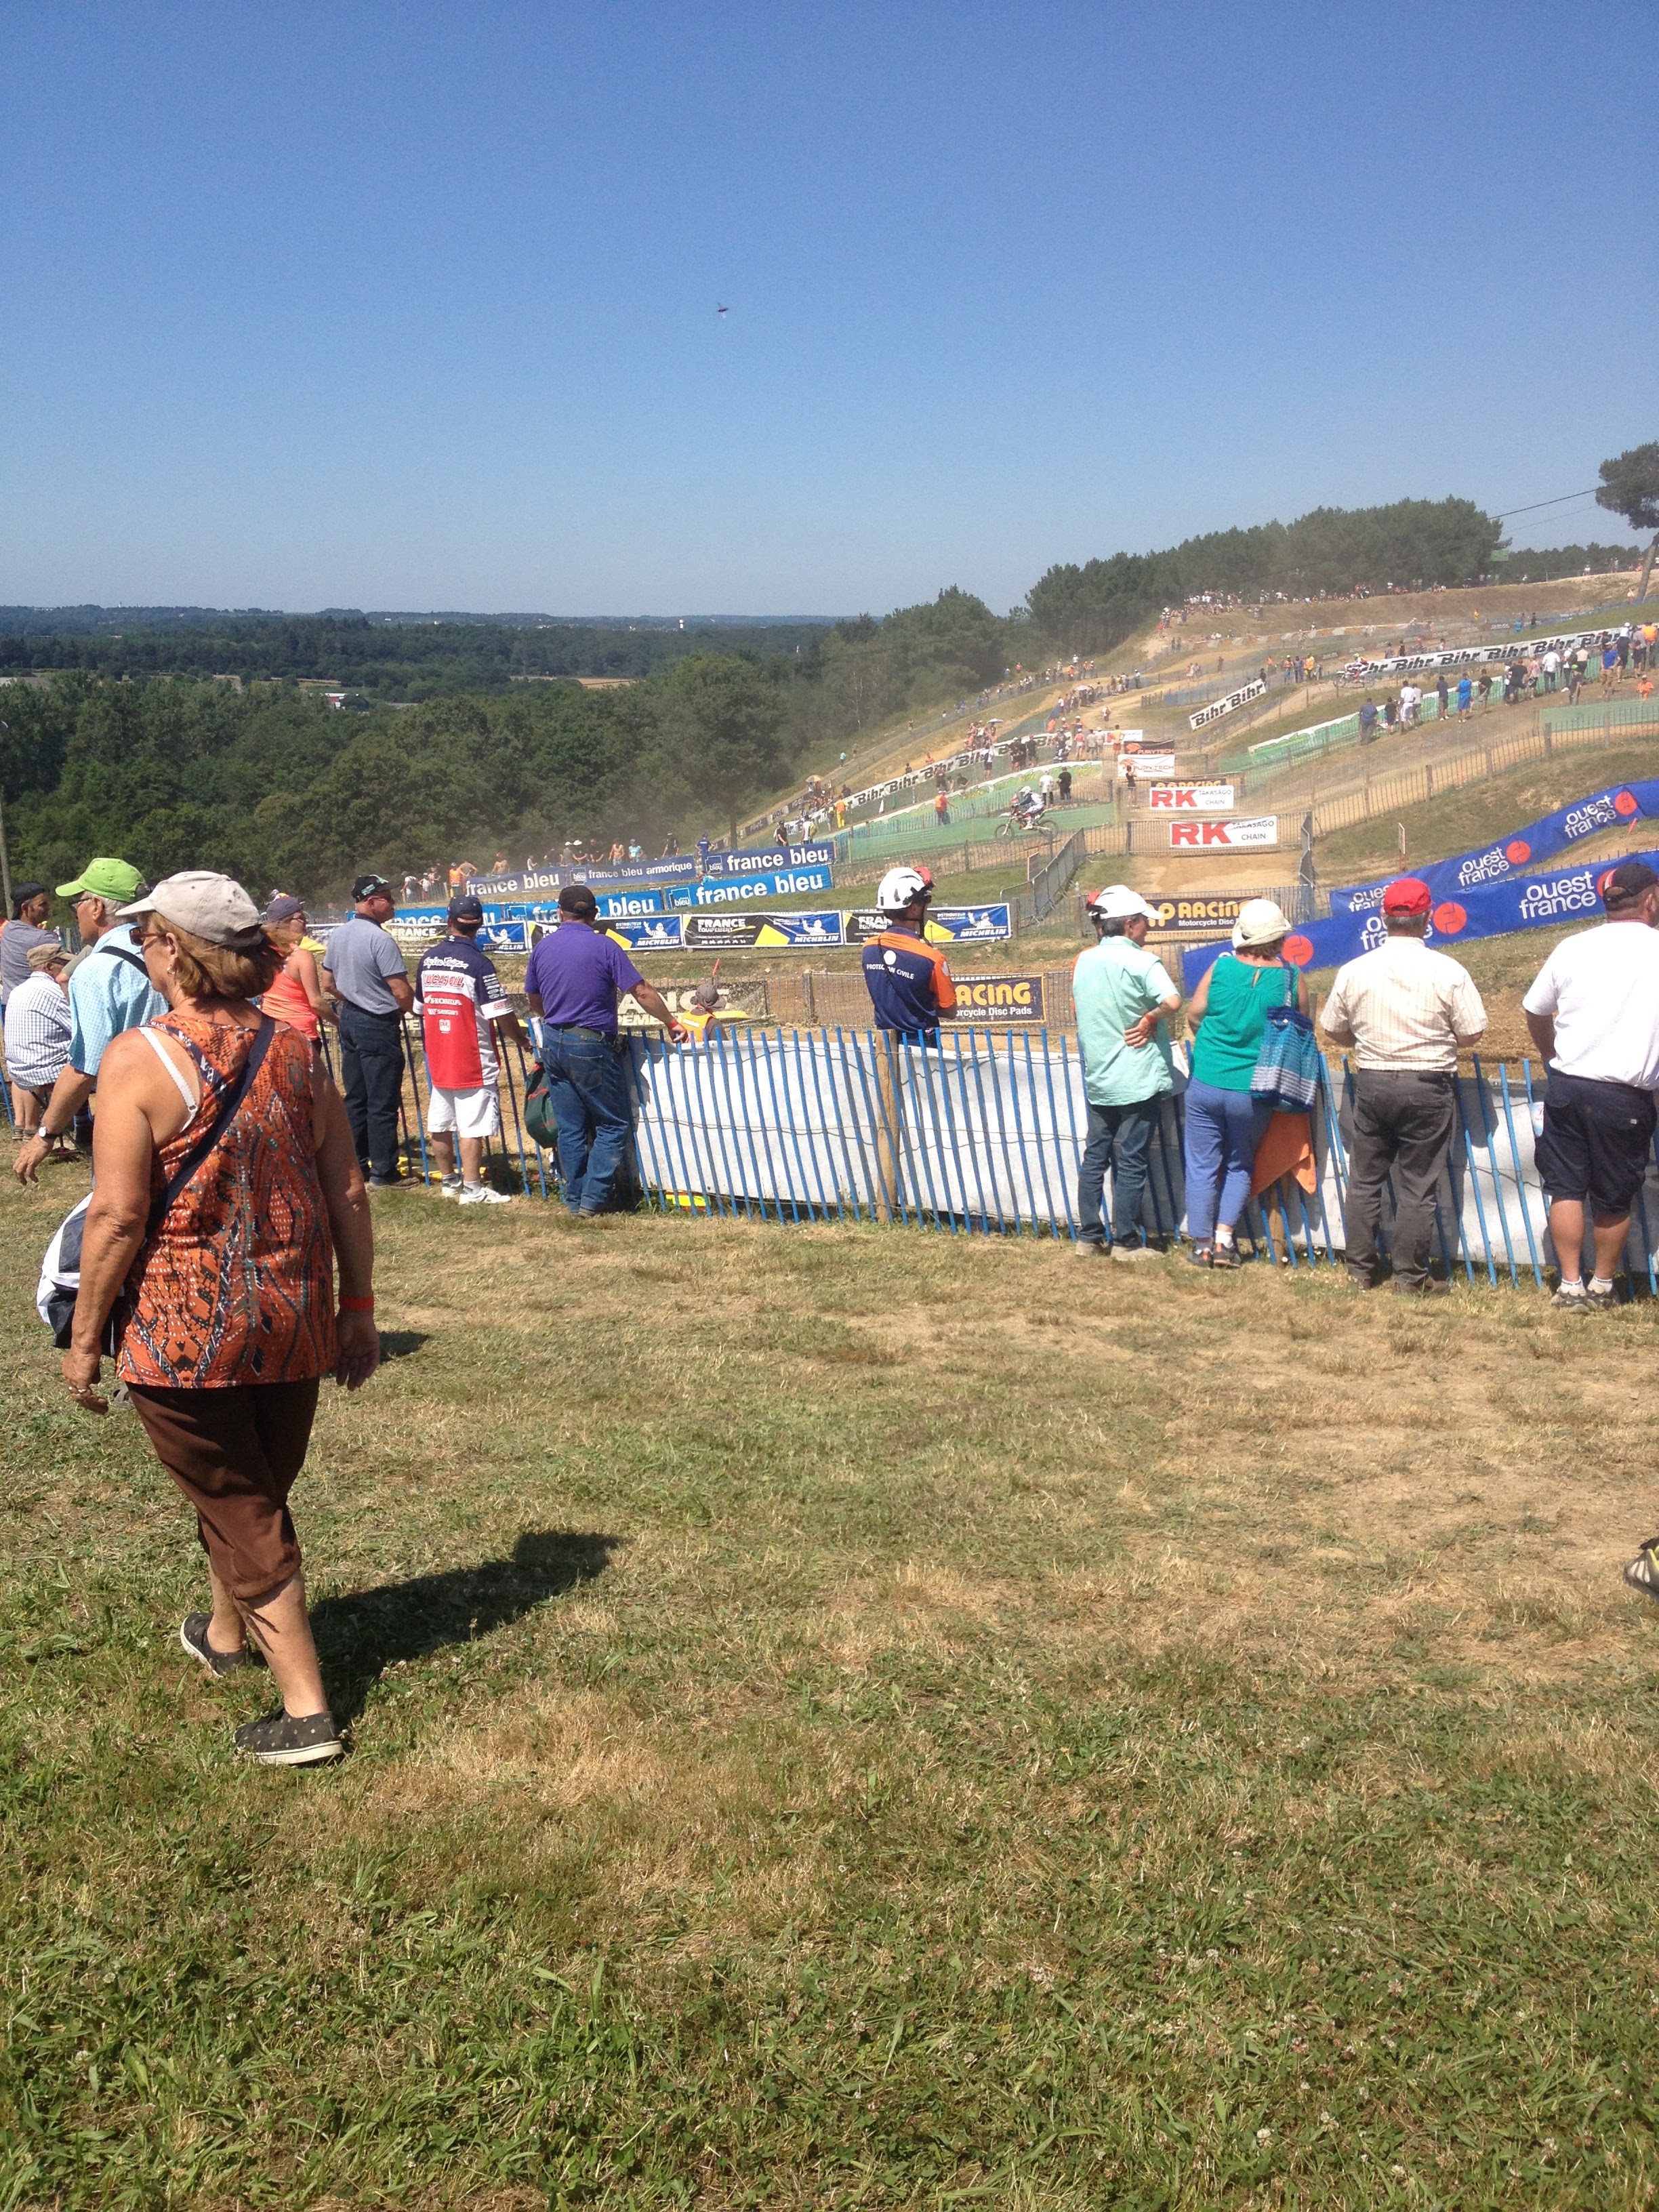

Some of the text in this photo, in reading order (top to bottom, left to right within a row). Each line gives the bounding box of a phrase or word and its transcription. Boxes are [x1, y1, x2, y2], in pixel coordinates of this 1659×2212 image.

[1391, 657, 1434, 671] Bihr
[1437, 652, 1480, 665] Bihr
[1483, 644, 1528, 660] Bihr
[1191, 683, 1263, 726] Bihr Bihr
[855, 787, 884, 806] Bihr
[885, 775, 918, 793] Bihr
[1151, 790, 1197, 807] RK
[1567, 796, 1614, 825] ouest
[1172, 822, 1232, 845] RK
[1564, 809, 1617, 838] france
[588, 862, 693, 879] france bleu armorique
[727, 848, 828, 872] france bleu
[1462, 846, 1506, 873] ouest
[466, 872, 560, 896] france bleu
[1458, 859, 1510, 886] france
[696, 874, 823, 905] france bleu
[1526, 871, 1595, 901] ouest
[609, 897, 655, 916] bleu
[1519, 891, 1597, 919] france
[392, 928, 436, 937] FRANCE
[697, 918, 745, 928] FRANCE
[960, 928, 1006, 937] MICHELIN
[1178, 918, 1217, 928] Motorcycle
[897, 969, 914, 979] CIVILE
[430, 998, 462, 1006] HONDA
[955, 982, 1031, 1006] ACING
[988, 1007, 1008, 1016] Disc
[1010, 1006, 1032, 1015] Pads
